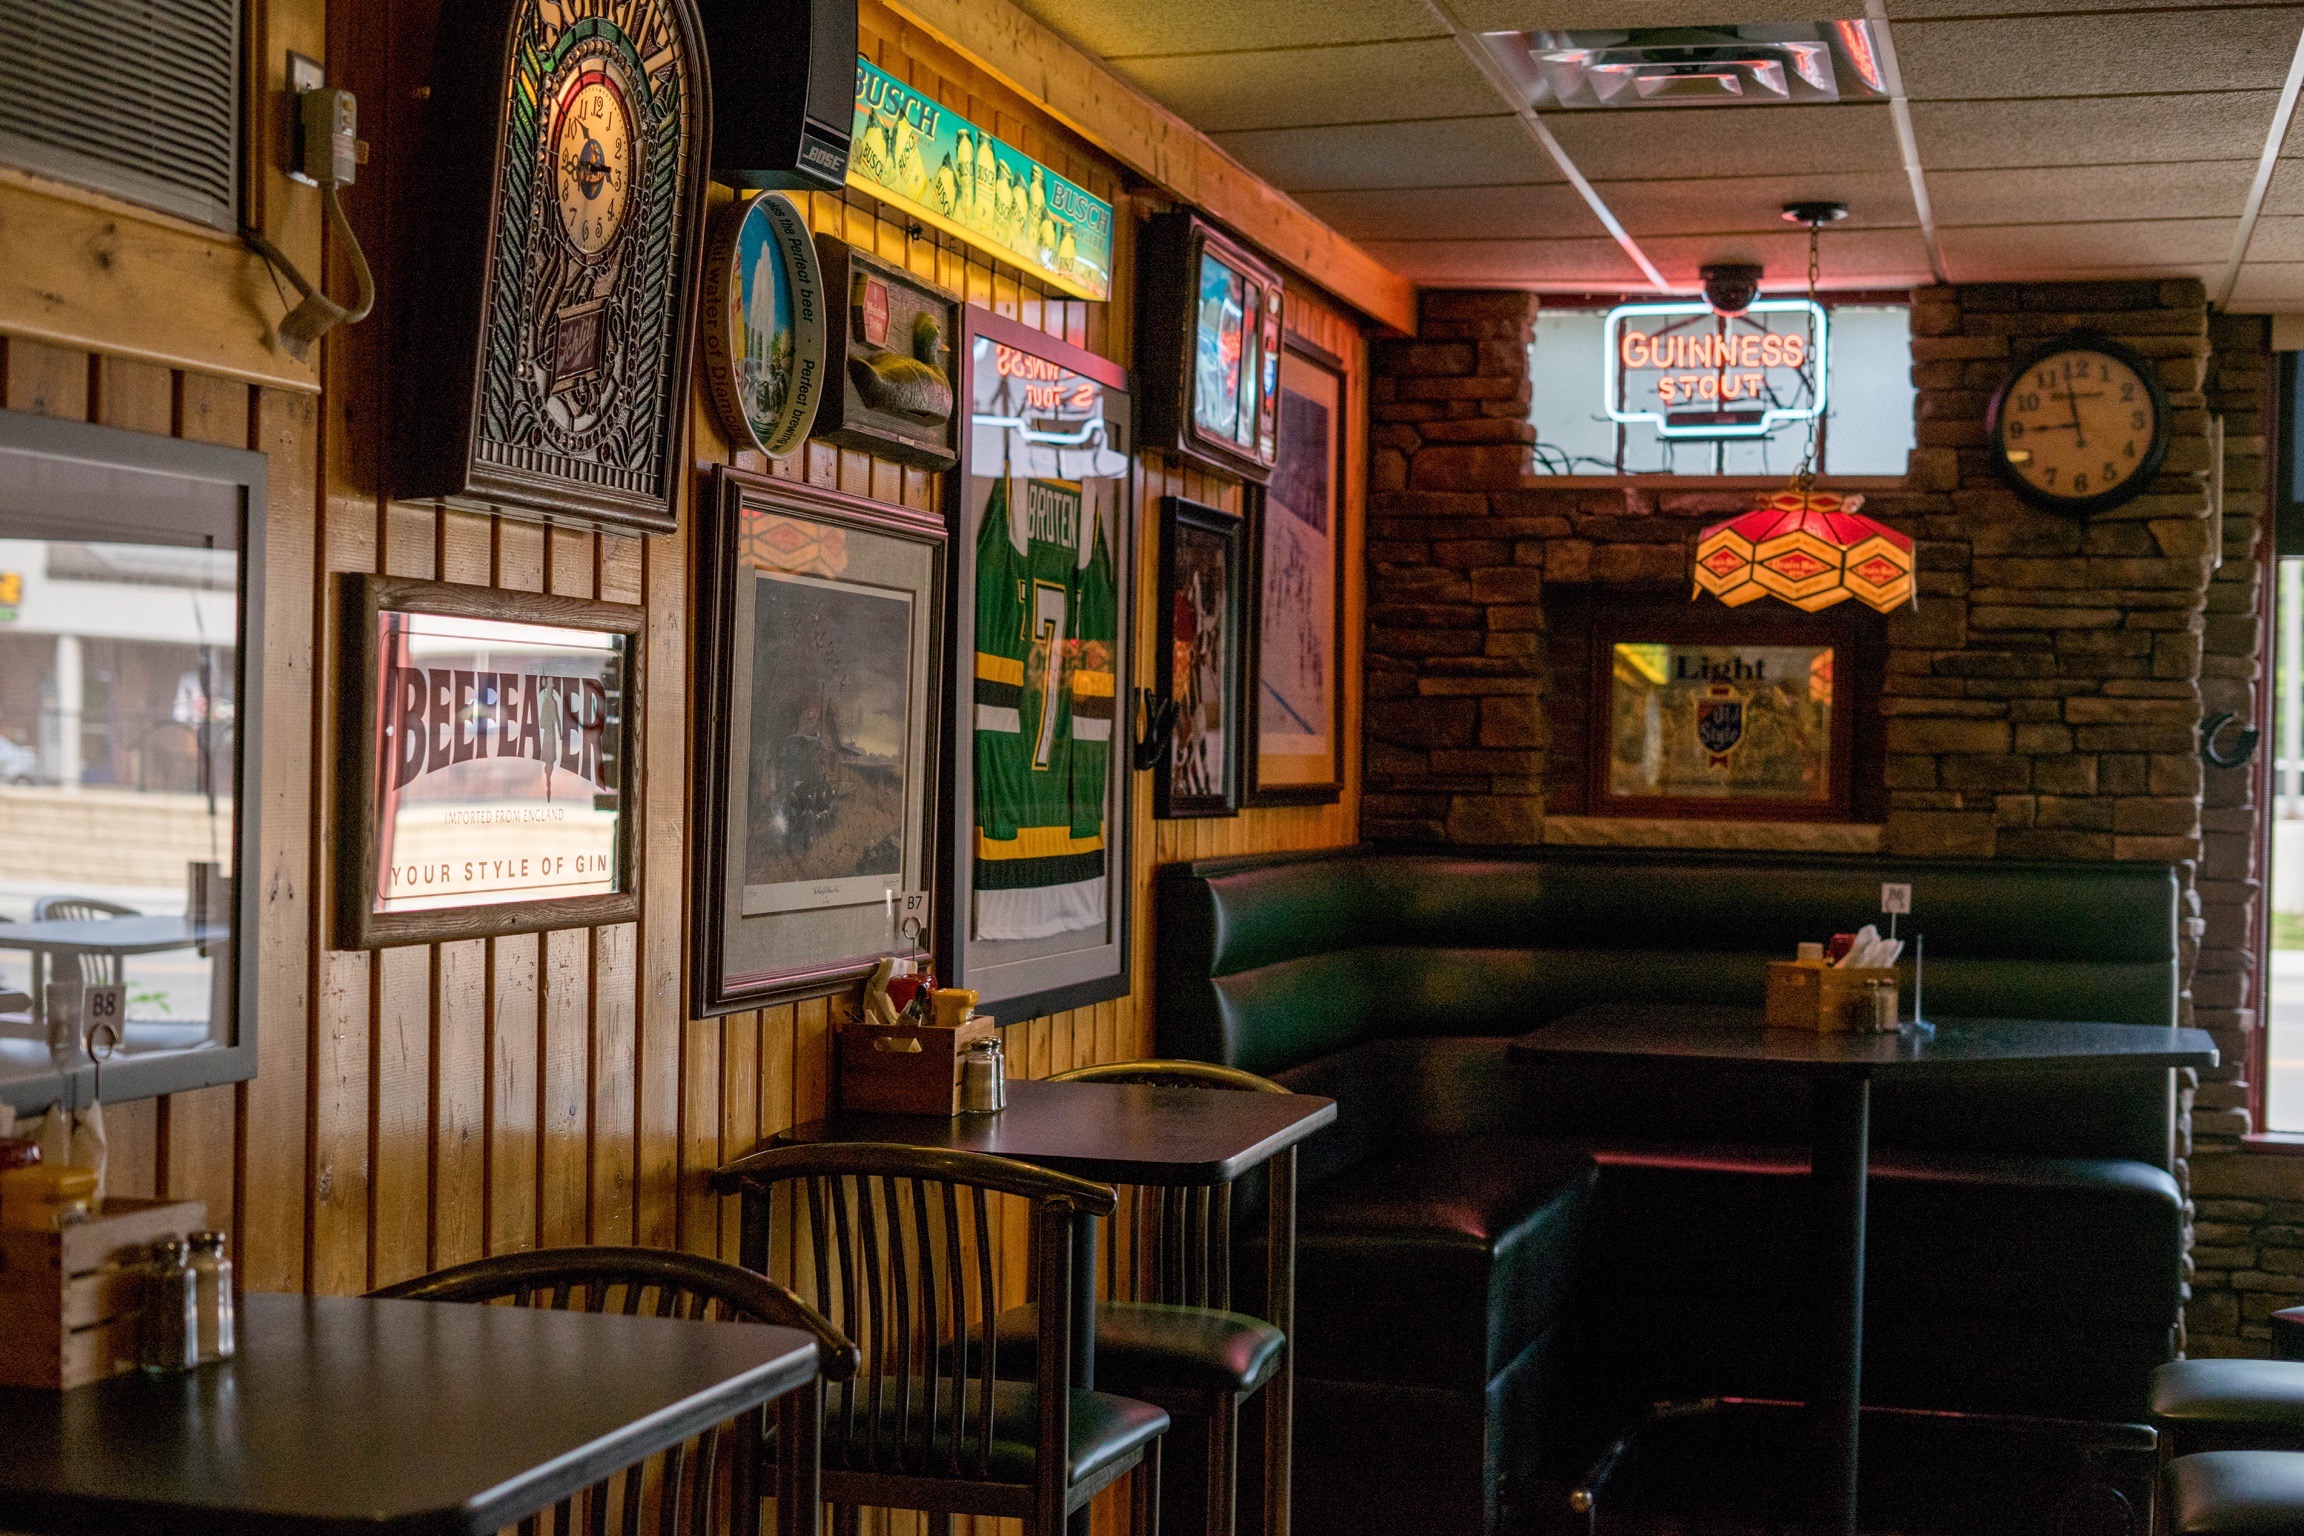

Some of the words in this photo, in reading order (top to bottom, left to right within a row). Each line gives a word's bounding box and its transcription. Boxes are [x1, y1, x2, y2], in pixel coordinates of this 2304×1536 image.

[578, 98, 588, 121] 11
[591, 96, 604, 119] 12
[856, 67, 939, 142] BUSCH
[565, 117, 577, 140] 10
[606, 111, 613, 131] 1
[562, 147, 569, 164] 9
[614, 137, 622, 160] 2
[803, 145, 845, 172] BOSE
[562, 178, 569, 202] 8
[614, 170, 622, 192] 3
[569, 207, 577, 227] 7
[607, 198, 614, 222] 4
[1050, 180, 1112, 236] BUSCH
[582, 220, 589, 242] 6
[595, 217, 602, 239] 5
[780, 218, 795, 235] the
[789, 238, 812, 285] Perfect
[800, 288, 814, 324] beer
[1622, 332, 1805, 369] GUINNESS
[797, 359, 815, 407] Perfect
[2037, 370, 2056, 389] 11
[2101, 364, 2110, 383] 1
[1658, 373, 1764, 400] STOUT
[2120, 382, 2134, 402] 2
[2018, 393, 2040, 412] 10
[778, 408, 805, 446] brewing
[2123, 439, 2135, 458] 4
[2044, 466, 2057, 486] 7
[2074, 472, 2088, 493] 6
[1027, 484, 1078, 549] BROTEN
[1031, 577, 1068, 772] 7
[1676, 656, 1766, 684] Light
[392, 666, 607, 792] BEEFEATER
[444, 811, 493, 825] IMPORTED
[495, 810, 521, 823] FROM
[523, 808, 564, 823] ENGLAND
[391, 864, 451, 886] YOUR
[464, 858, 529, 881] STYLE
[541, 856, 564, 876] OF
[575, 854, 607, 873] GIN
[907, 895, 922, 910] B7
[93, 992, 117, 1017] B8
